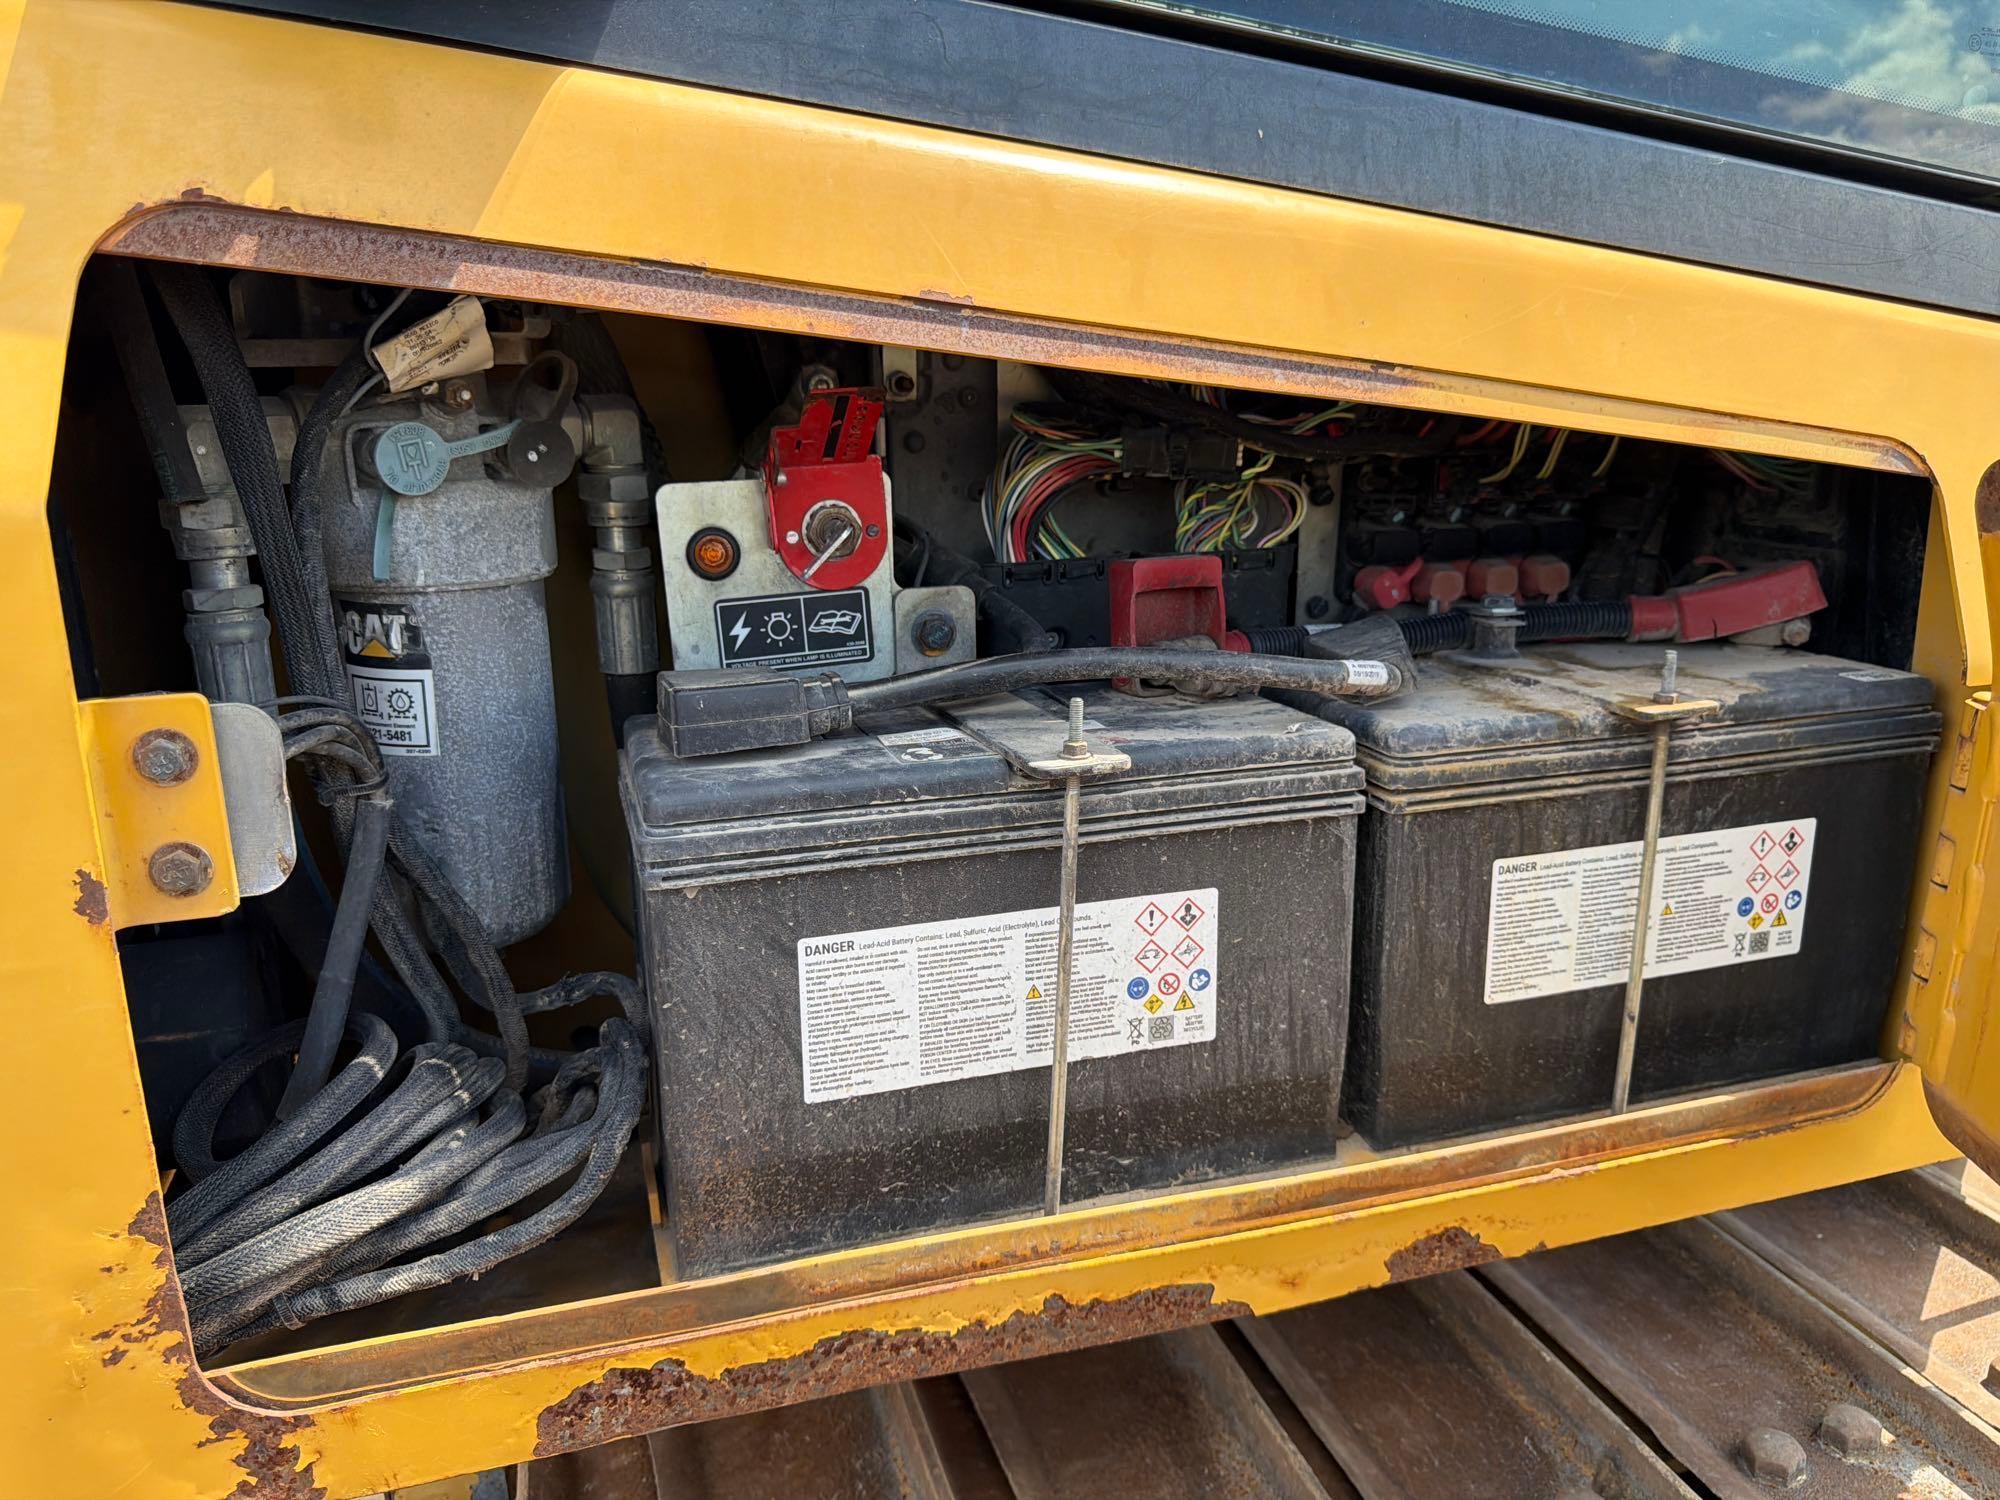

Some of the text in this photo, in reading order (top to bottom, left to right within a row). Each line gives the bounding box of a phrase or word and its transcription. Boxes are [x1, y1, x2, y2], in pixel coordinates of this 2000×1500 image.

[346, 611, 406, 658] CAT
[758, 659, 784, 668] PRESENT
[826, 650, 862, 660] ILLUMINATED
[1498, 862, 1537, 876] DANGER
[804, 940, 854, 956] DANGER
[858, 939, 890, 950] Lead-Acid
[914, 934, 943, 942] Contains:
[945, 930, 962, 938] Lead,
[963, 928, 986, 937] Sulfuric
[1002, 920, 1040, 932] (Electrolyte),
[1040, 918, 1055, 926] Lead
[1056, 915, 1093, 925] Counds.
